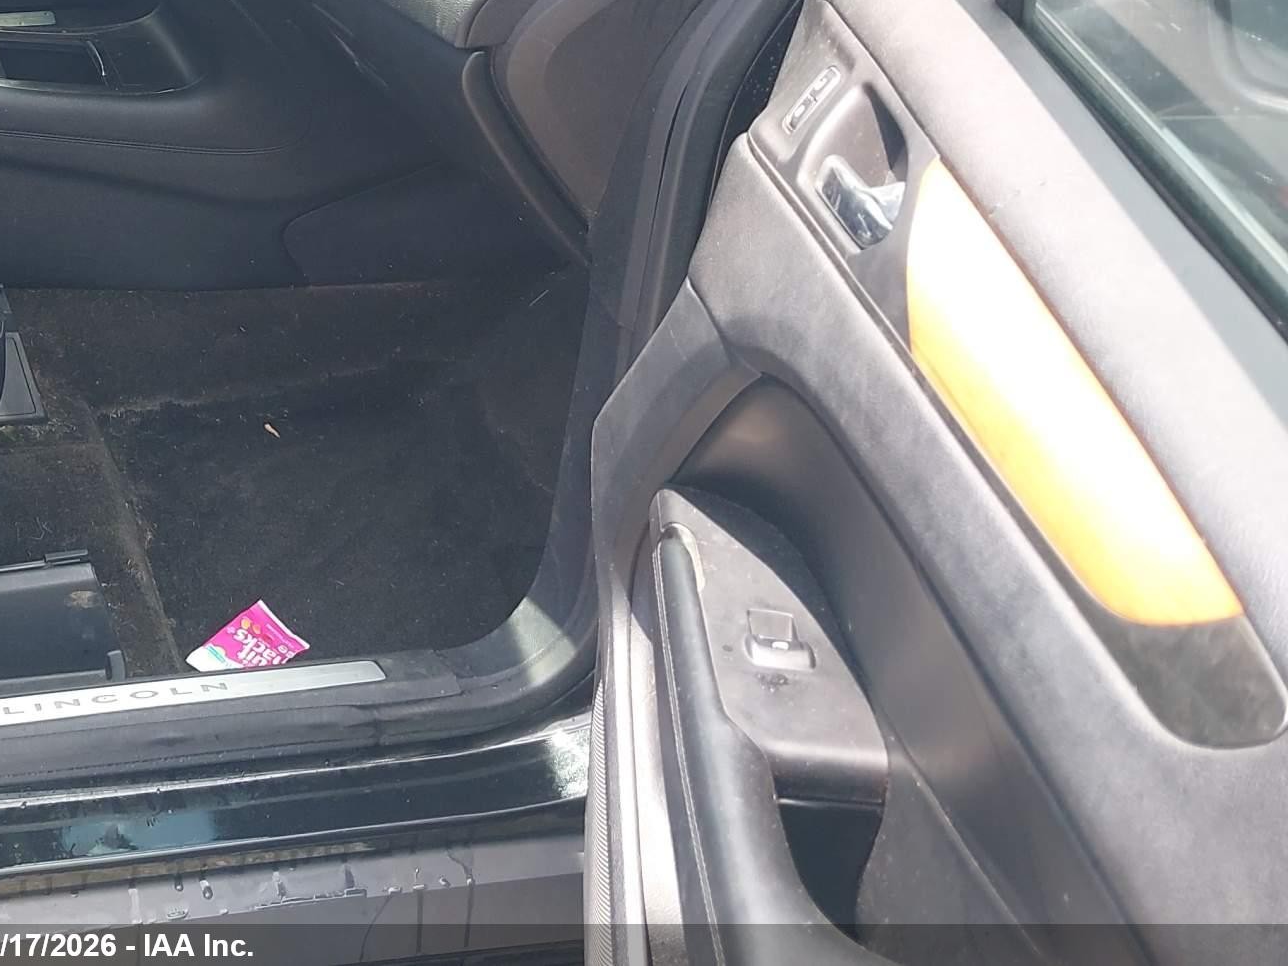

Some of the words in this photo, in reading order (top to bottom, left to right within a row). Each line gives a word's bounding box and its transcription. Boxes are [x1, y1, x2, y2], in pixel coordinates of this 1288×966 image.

[233, 629, 289, 665] nacks
[237, 644, 268, 666] uit
[2, 682, 228, 715] LINCOLN
